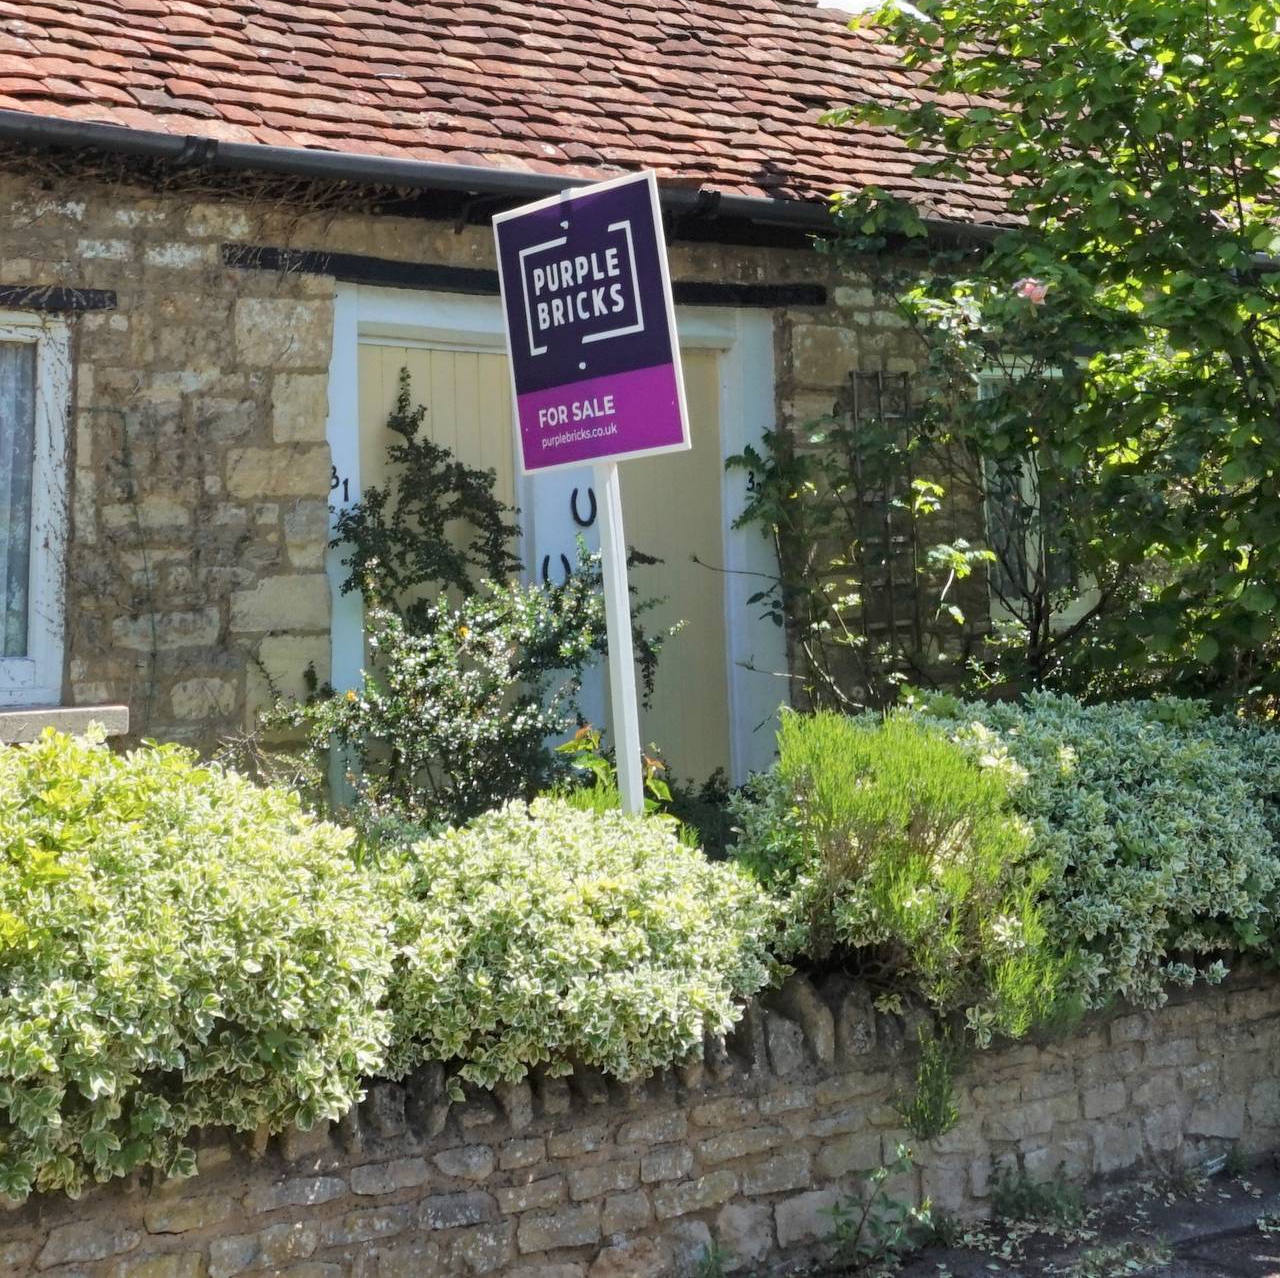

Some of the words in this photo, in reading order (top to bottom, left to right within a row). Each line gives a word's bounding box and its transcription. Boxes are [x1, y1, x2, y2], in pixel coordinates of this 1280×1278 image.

[533, 247, 620, 296] PURPLE
[537, 283, 625, 331] BRICKS
[538, 405, 569, 428] FOR
[571, 395, 616, 421] SALE
[542, 422, 618, 450] purplebricks.co.uk
